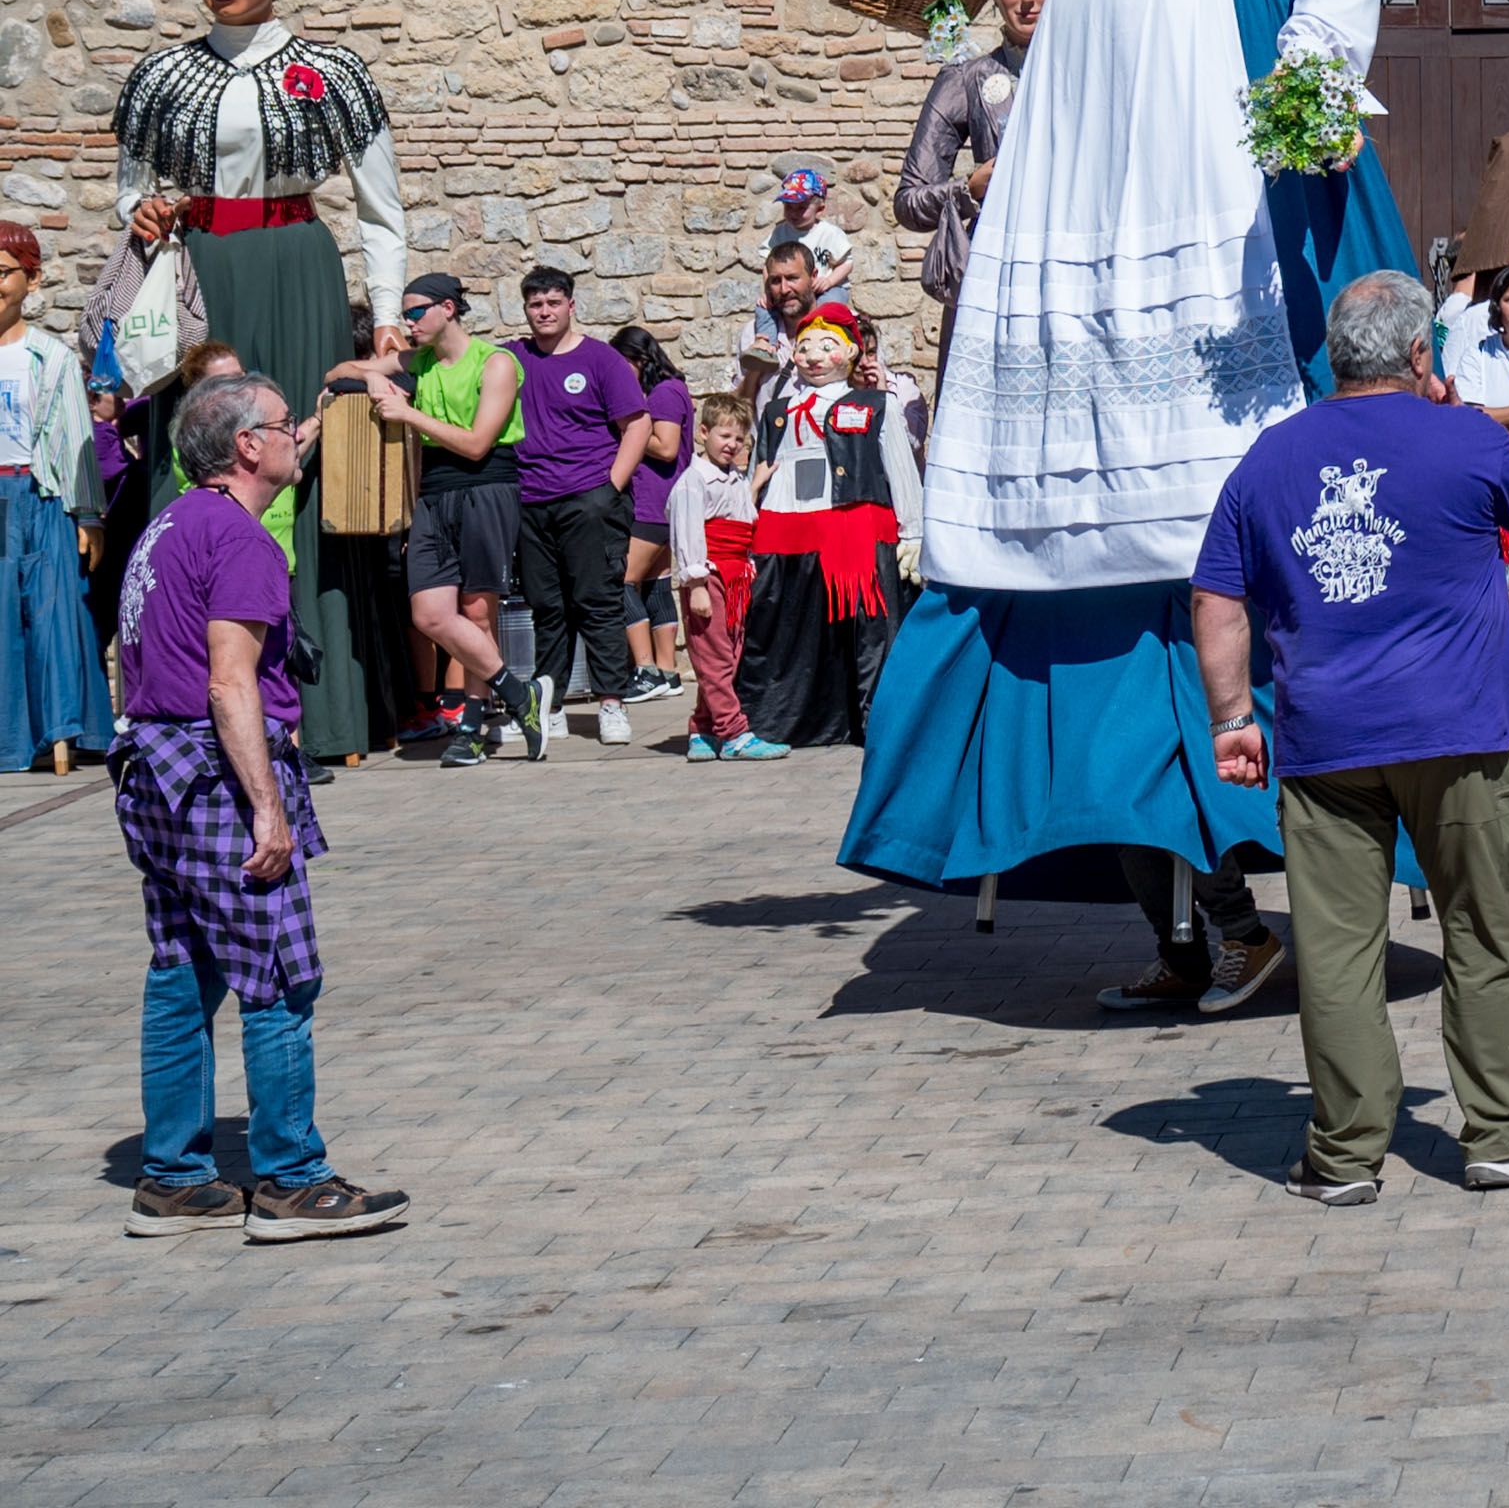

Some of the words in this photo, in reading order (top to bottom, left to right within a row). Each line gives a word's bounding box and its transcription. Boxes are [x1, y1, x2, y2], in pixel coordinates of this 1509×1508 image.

[124, 309, 171, 340] LOLA
[1291, 506, 1352, 556] Manelic
[1354, 514, 1363, 530] i
[1364, 507, 1407, 545] Núria
